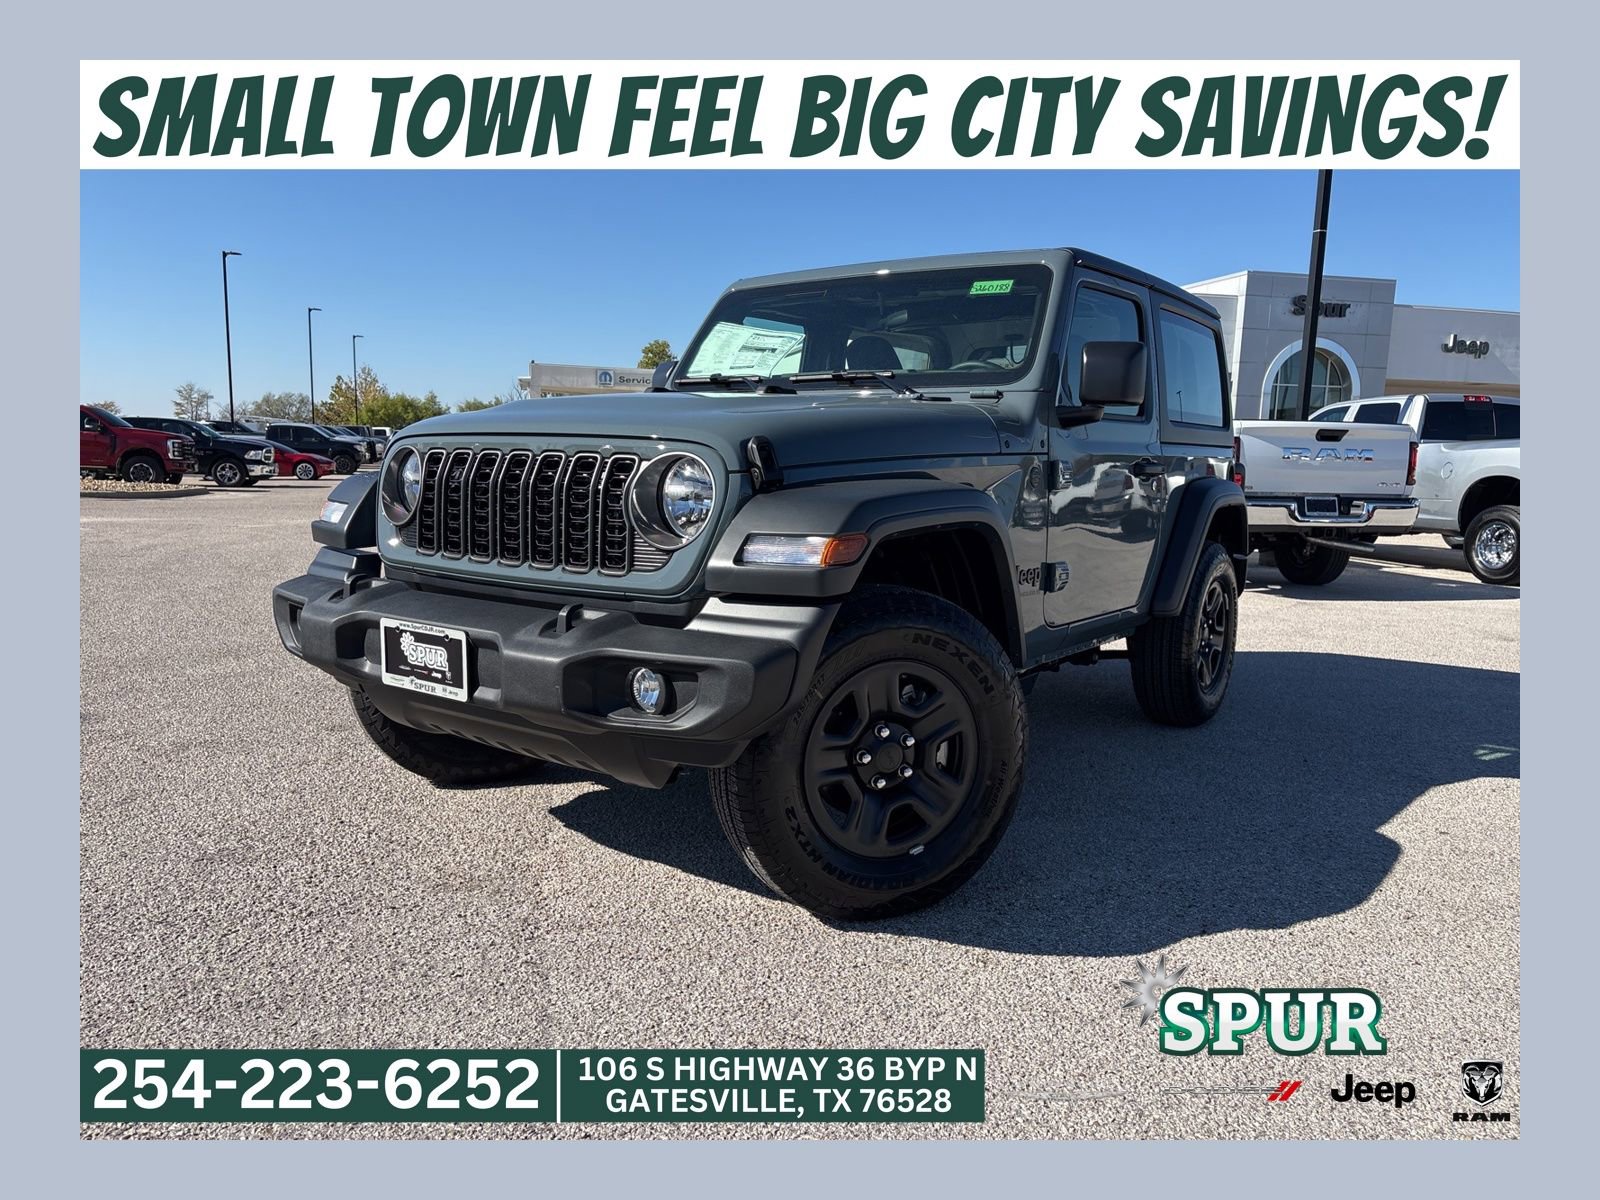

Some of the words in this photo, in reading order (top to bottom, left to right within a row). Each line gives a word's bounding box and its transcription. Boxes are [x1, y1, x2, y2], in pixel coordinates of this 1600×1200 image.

[1291, 295, 1351, 318] Sur
[1441, 334, 1490, 359] Jeep
[618, 375, 651, 385] Servic
[1281, 446, 1375, 463] RAM
[407, 641, 449, 671] SPUR
[912, 631, 995, 696] NEXEN
[413, 682, 437, 694] SPUR
